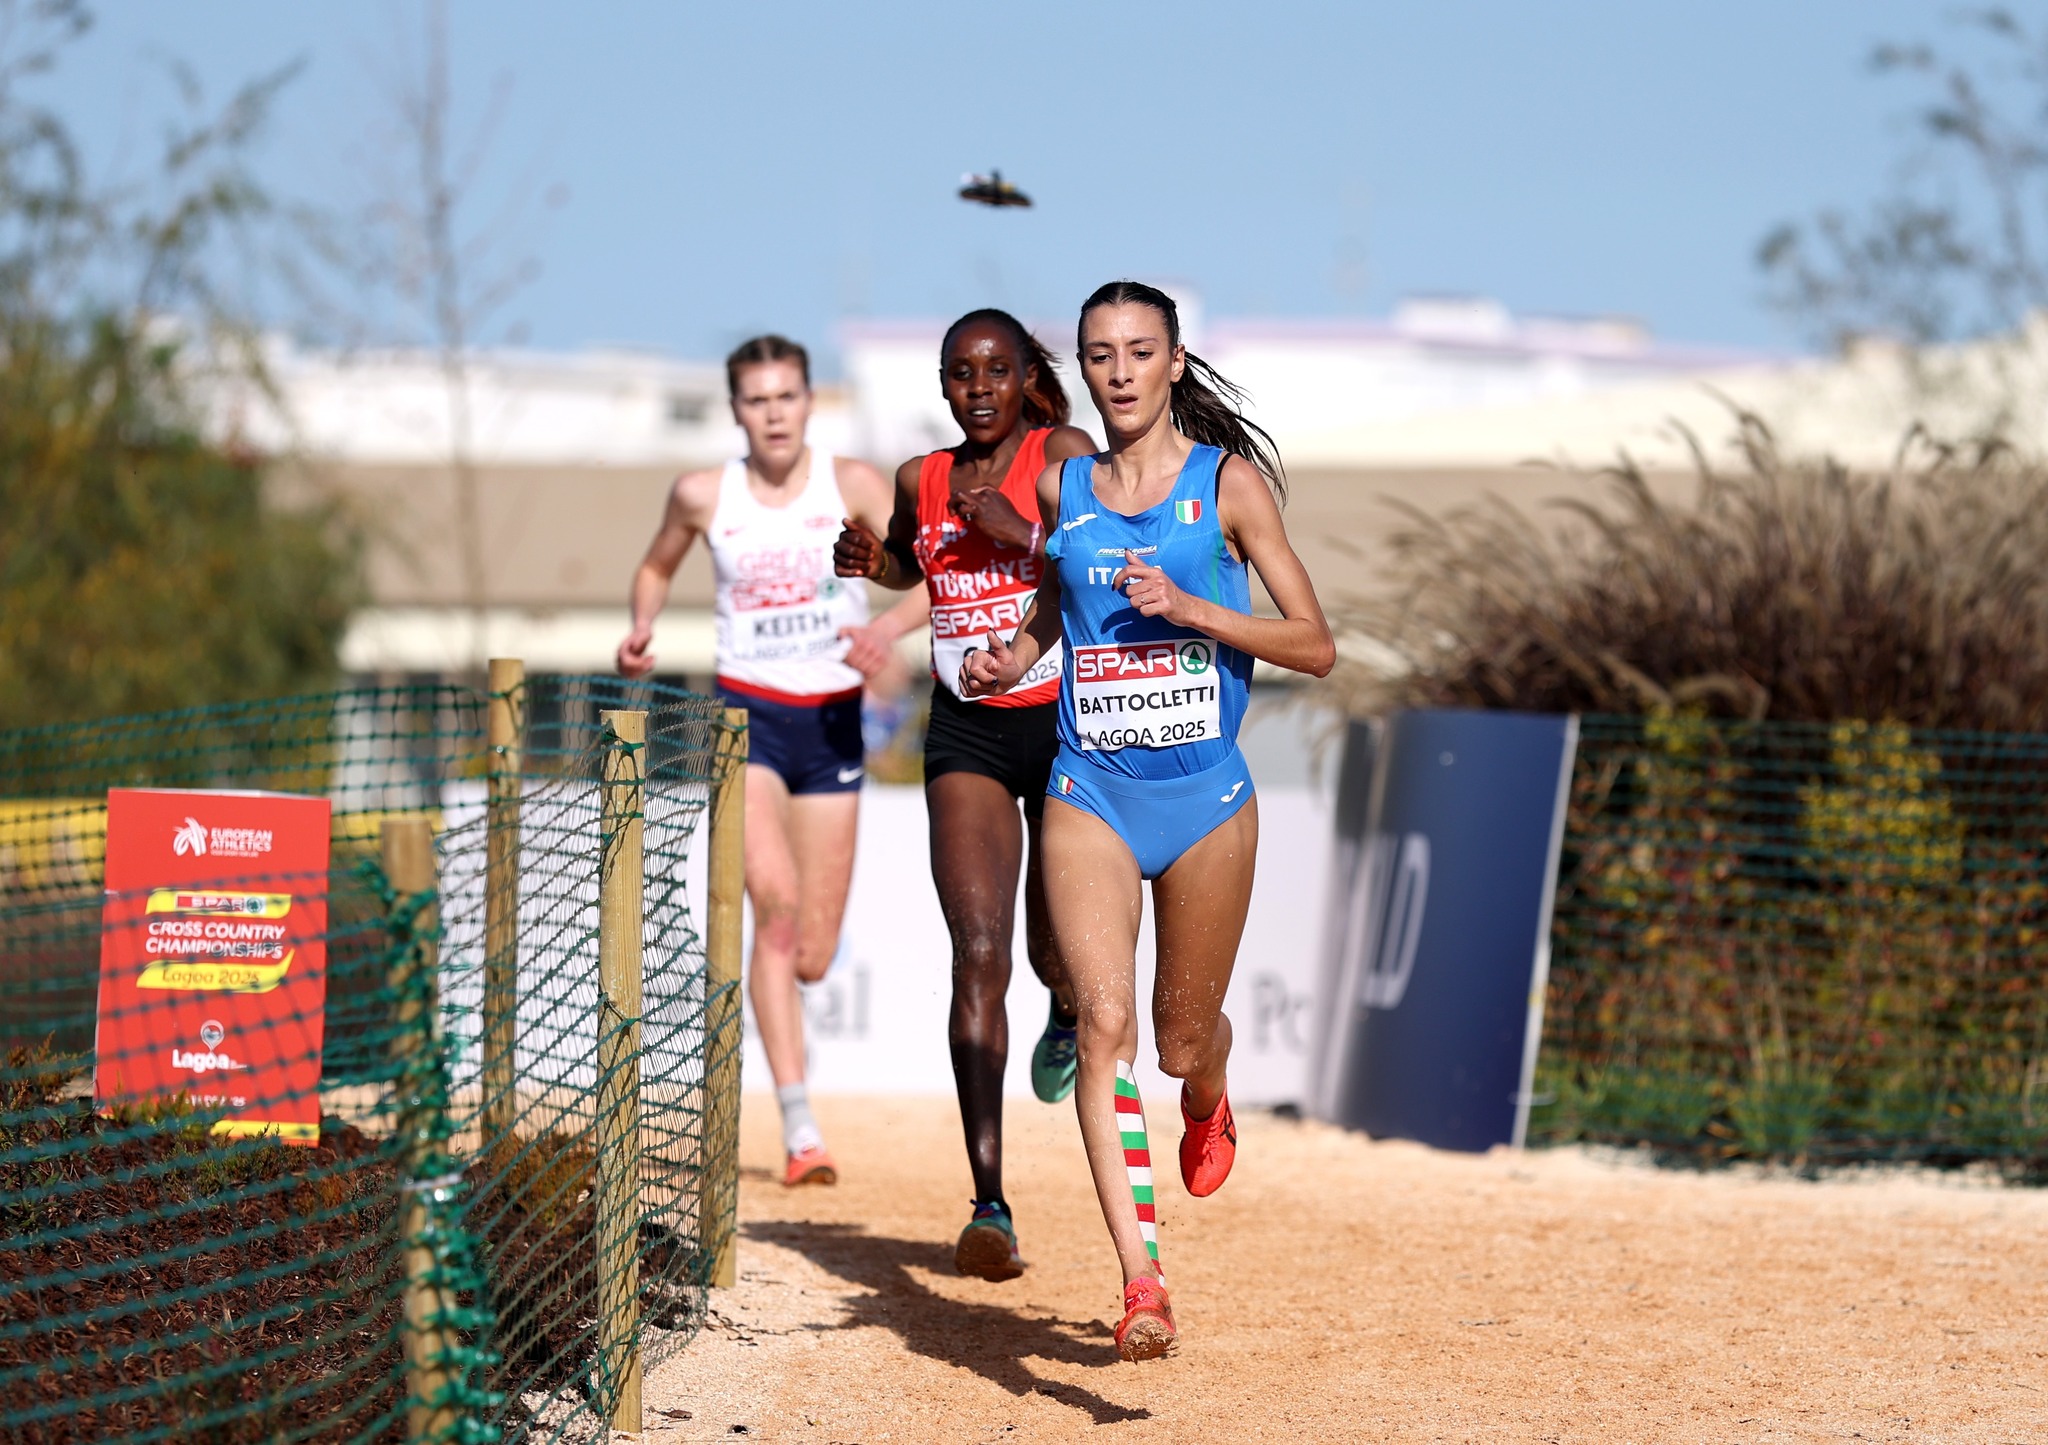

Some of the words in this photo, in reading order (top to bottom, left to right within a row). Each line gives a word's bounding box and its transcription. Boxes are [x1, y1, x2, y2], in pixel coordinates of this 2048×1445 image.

[932, 557, 1037, 599] TÜRKİYE
[754, 611, 830, 637] KEITH
[935, 603, 1019, 635] SPAR
[1078, 648, 1174, 678] SPAR
[1079, 686, 1215, 715] BATTOCLETTI
[1087, 728, 1155, 747] LAGOA
[1160, 720, 1206, 742] 2025
[210, 840, 272, 852] ATHLETICS
[211, 827, 273, 842] EUROPEAN
[148, 921, 203, 938] CROSS
[204, 922, 286, 940] COUNTRY
[145, 937, 284, 960] CHAMPIONSHIPS
[162, 968, 213, 988] Lagoa
[218, 970, 260, 985] 2025
[172, 1048, 230, 1073] Lagoa
